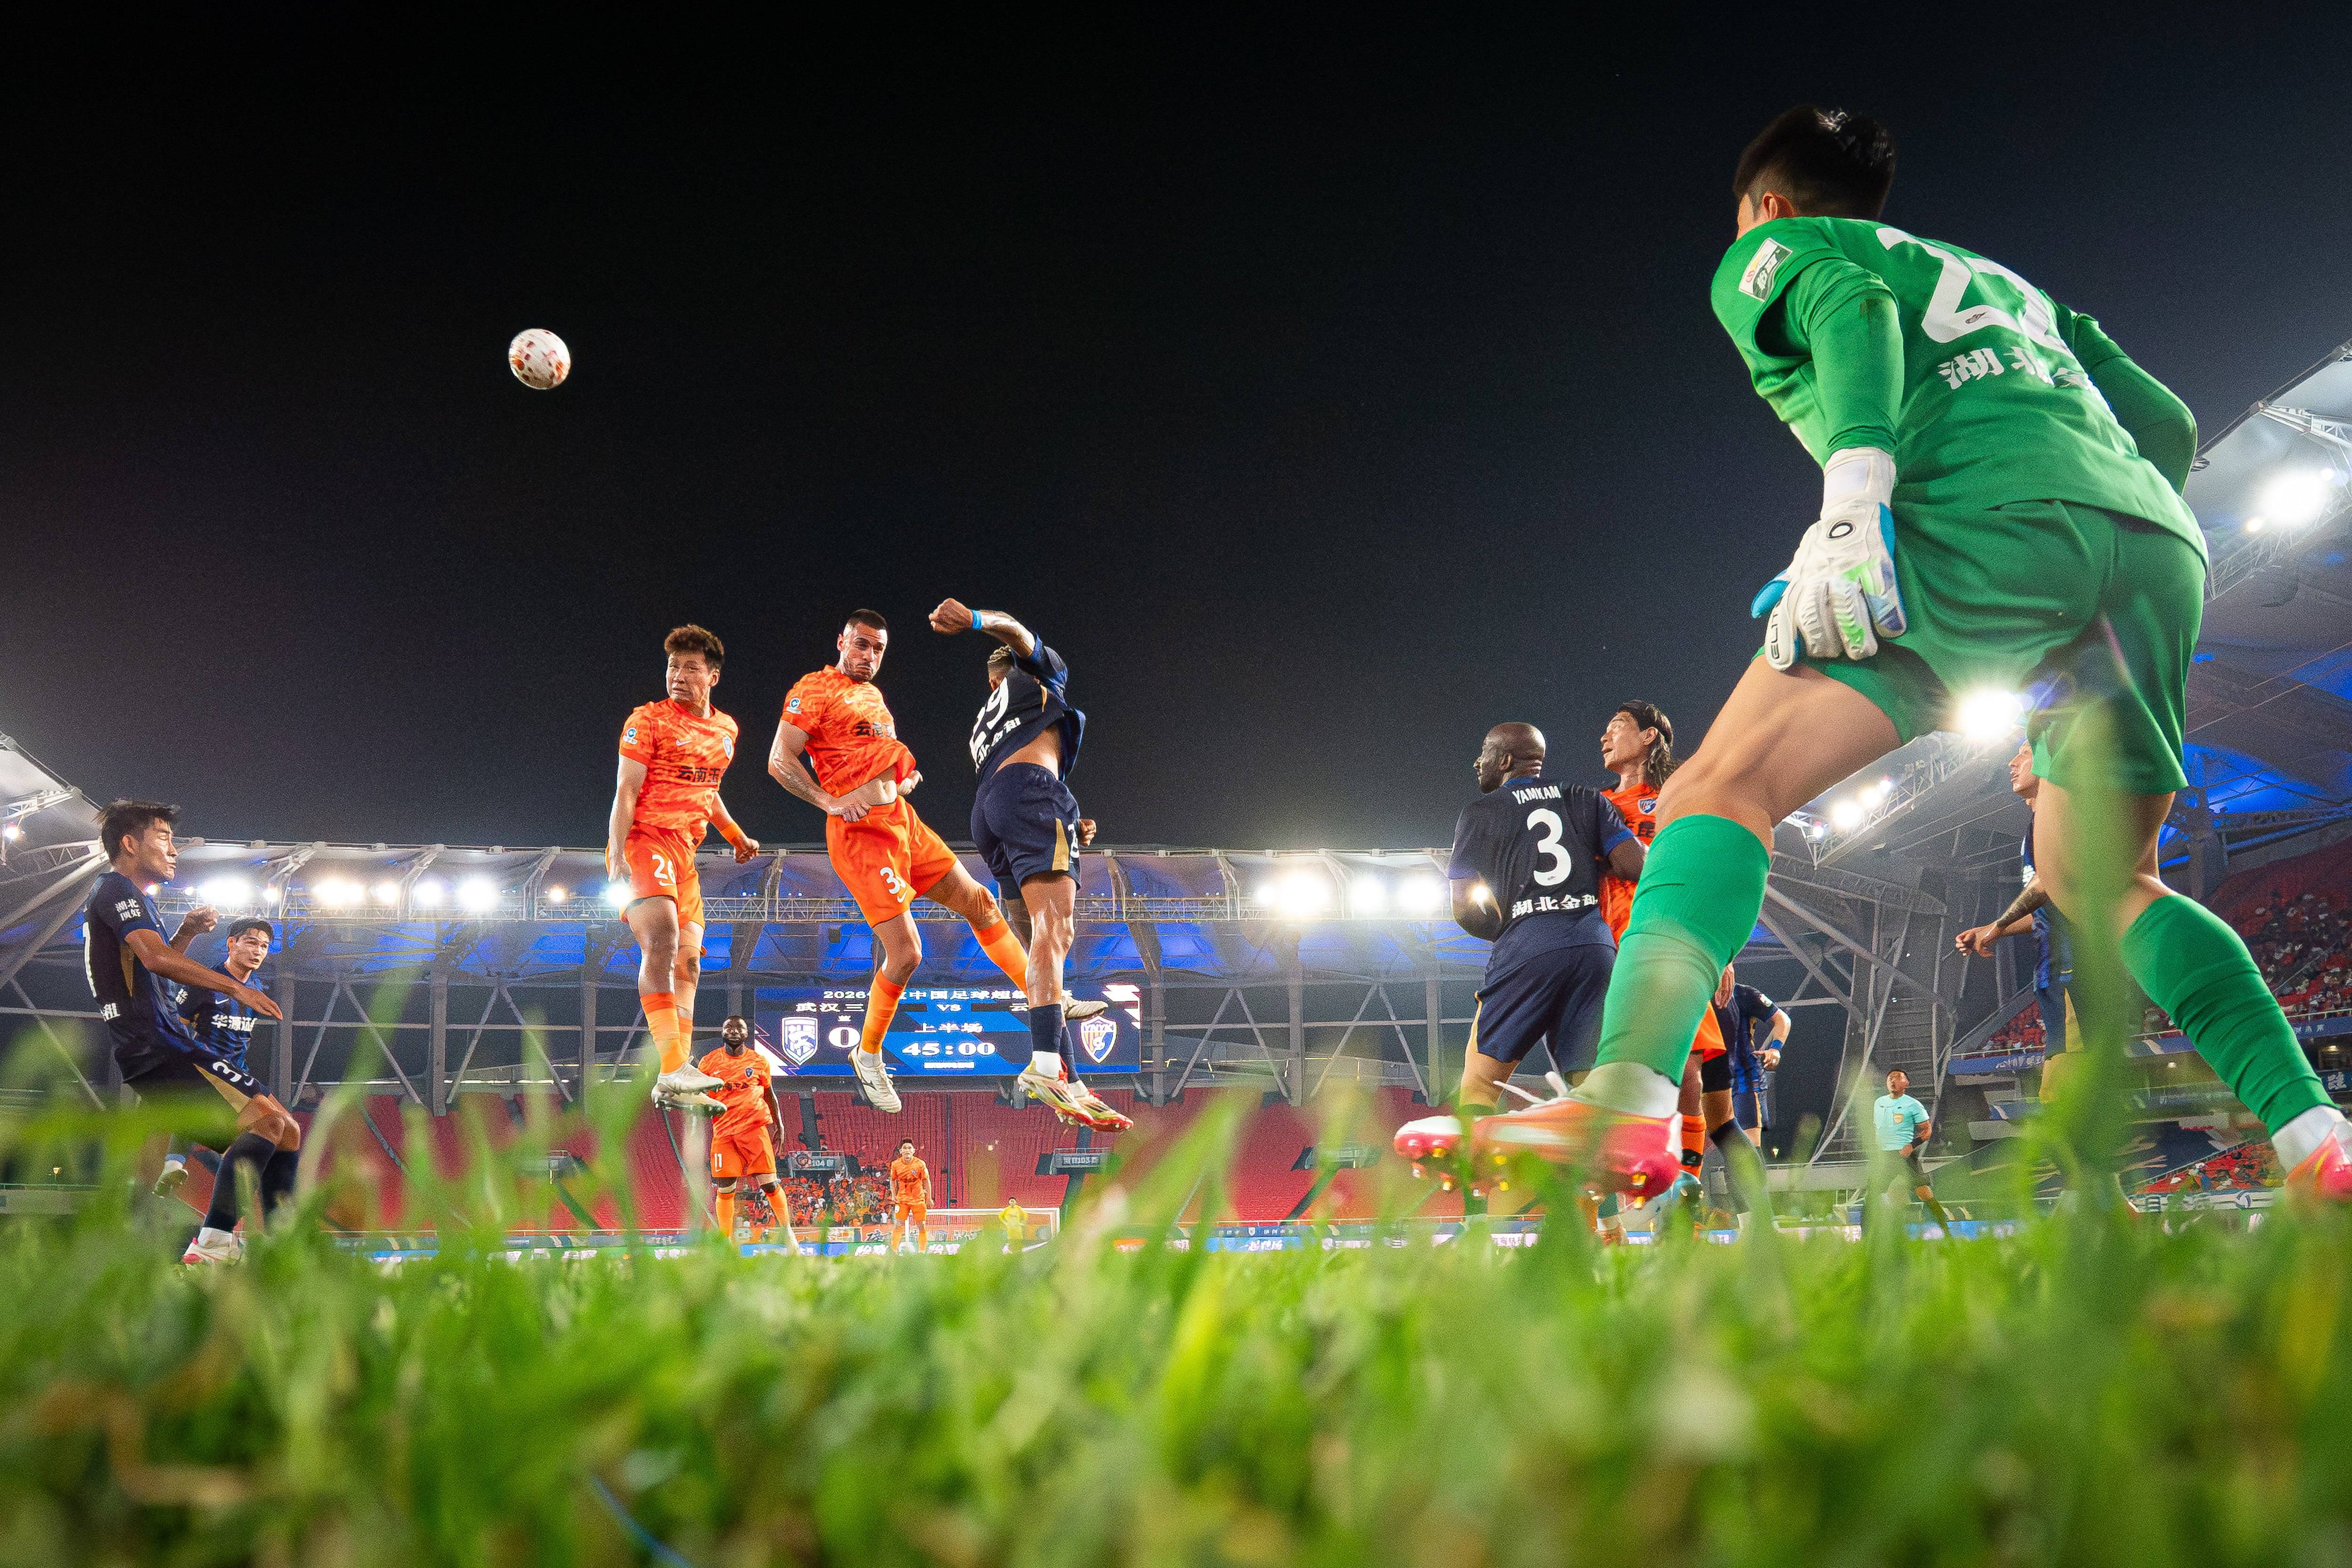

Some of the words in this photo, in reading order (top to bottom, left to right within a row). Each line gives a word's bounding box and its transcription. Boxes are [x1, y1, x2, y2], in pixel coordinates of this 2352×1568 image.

[1771, 596, 1783, 659] ELIT
[675, 765, 727, 783] 云南玉
[1512, 786, 1562, 804] YAMKAM
[1527, 808, 1572, 886] 3
[211, 1014, 258, 1032] 华源证
[914, 1022, 983, 1033] 上半场
[828, 1027, 861, 1048] 0
[902, 1042, 996, 1056] 45:00
[714, 1153, 722, 1168] 11
